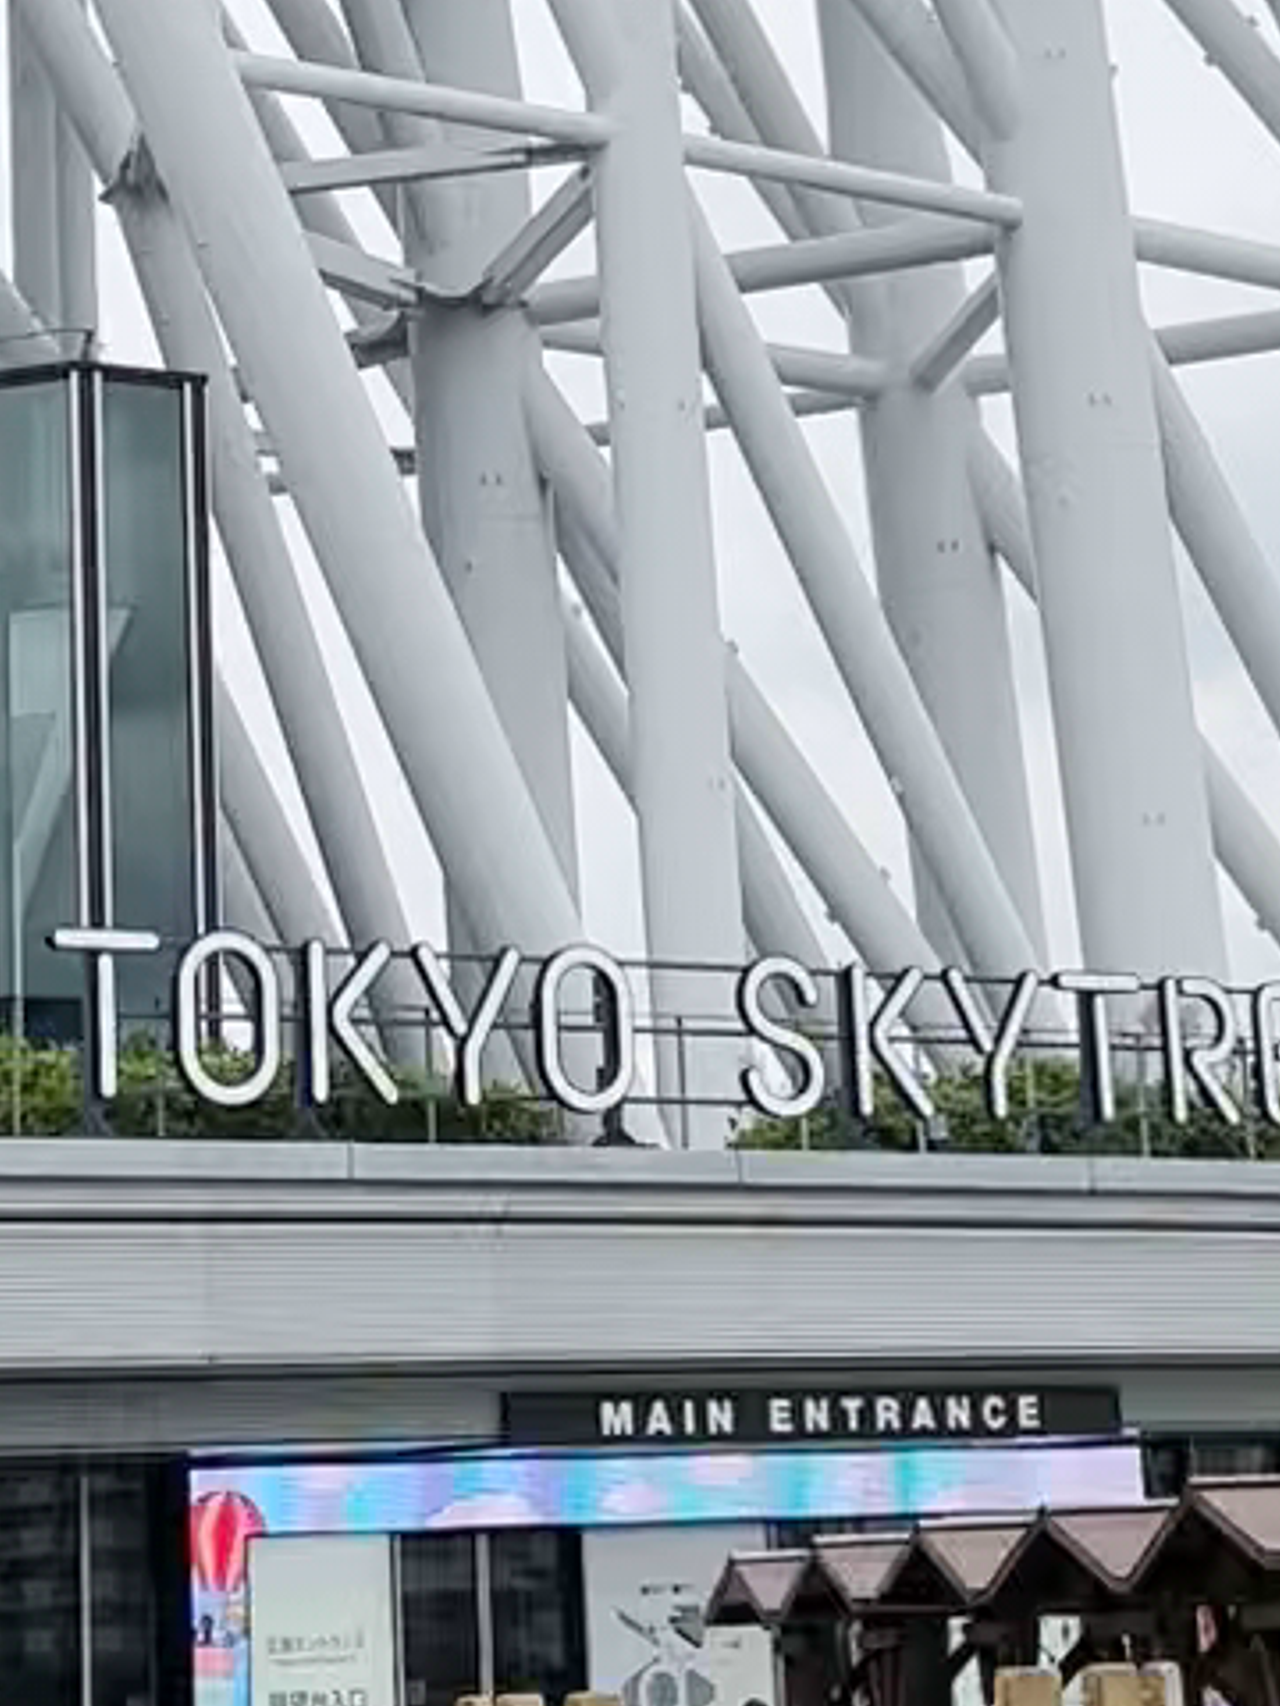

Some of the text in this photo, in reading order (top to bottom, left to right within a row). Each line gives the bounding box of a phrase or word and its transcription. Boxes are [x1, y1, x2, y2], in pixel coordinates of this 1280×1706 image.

[48, 928, 635, 1113] TOKYO
[600, 1394, 1043, 1436] MAIN ENTRANCE
